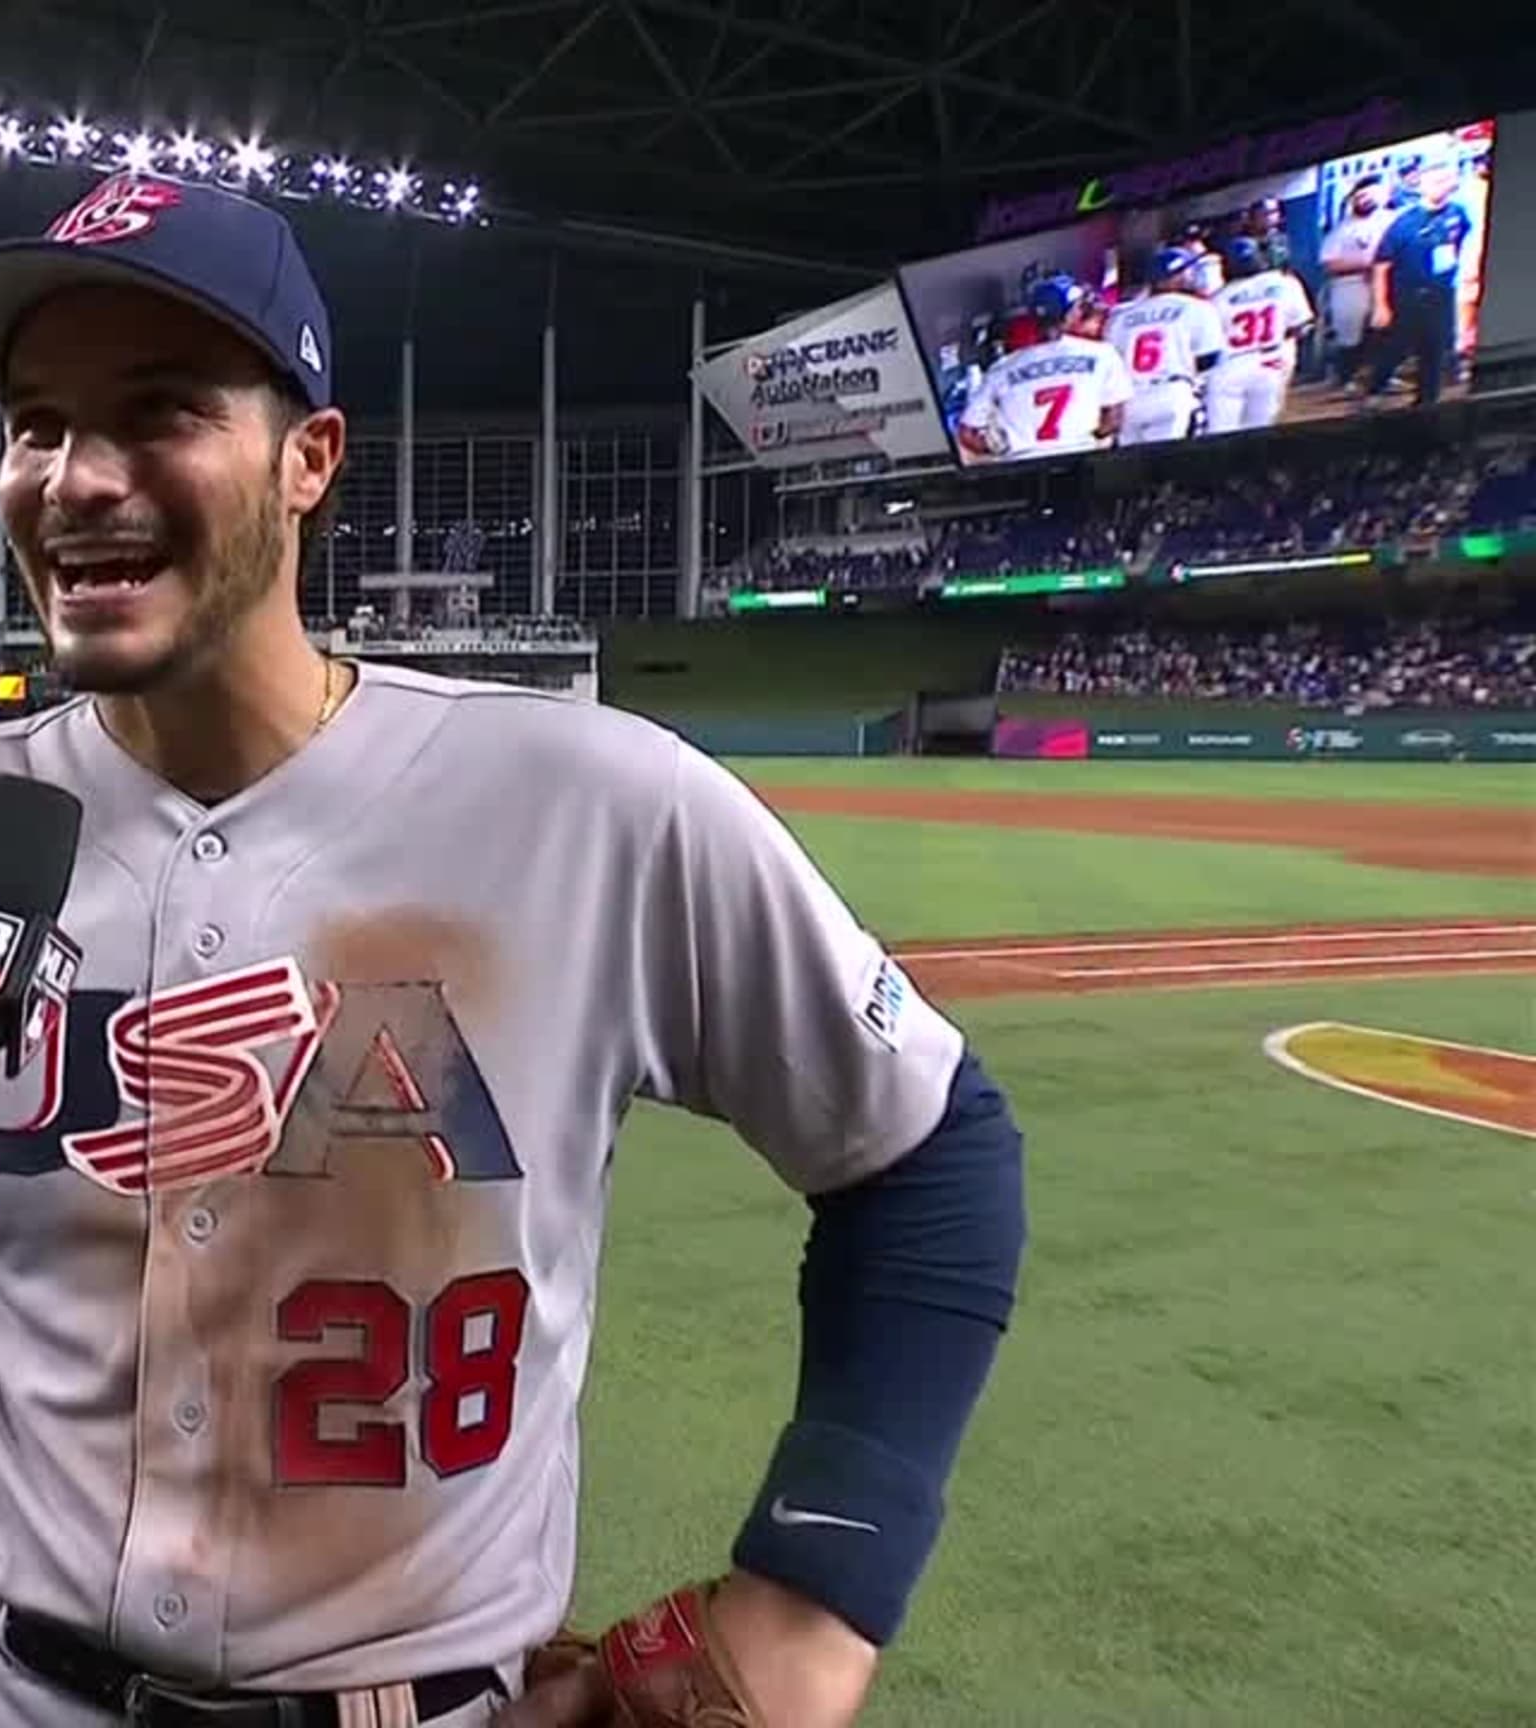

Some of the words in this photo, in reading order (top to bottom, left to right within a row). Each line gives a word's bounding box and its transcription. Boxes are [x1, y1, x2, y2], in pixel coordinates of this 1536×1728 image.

[1229, 304, 1276, 348] 31
[1133, 331, 1164, 373] 6
[1033, 384, 1073, 441] 7
[276, 1267, 530, 1487] 28
